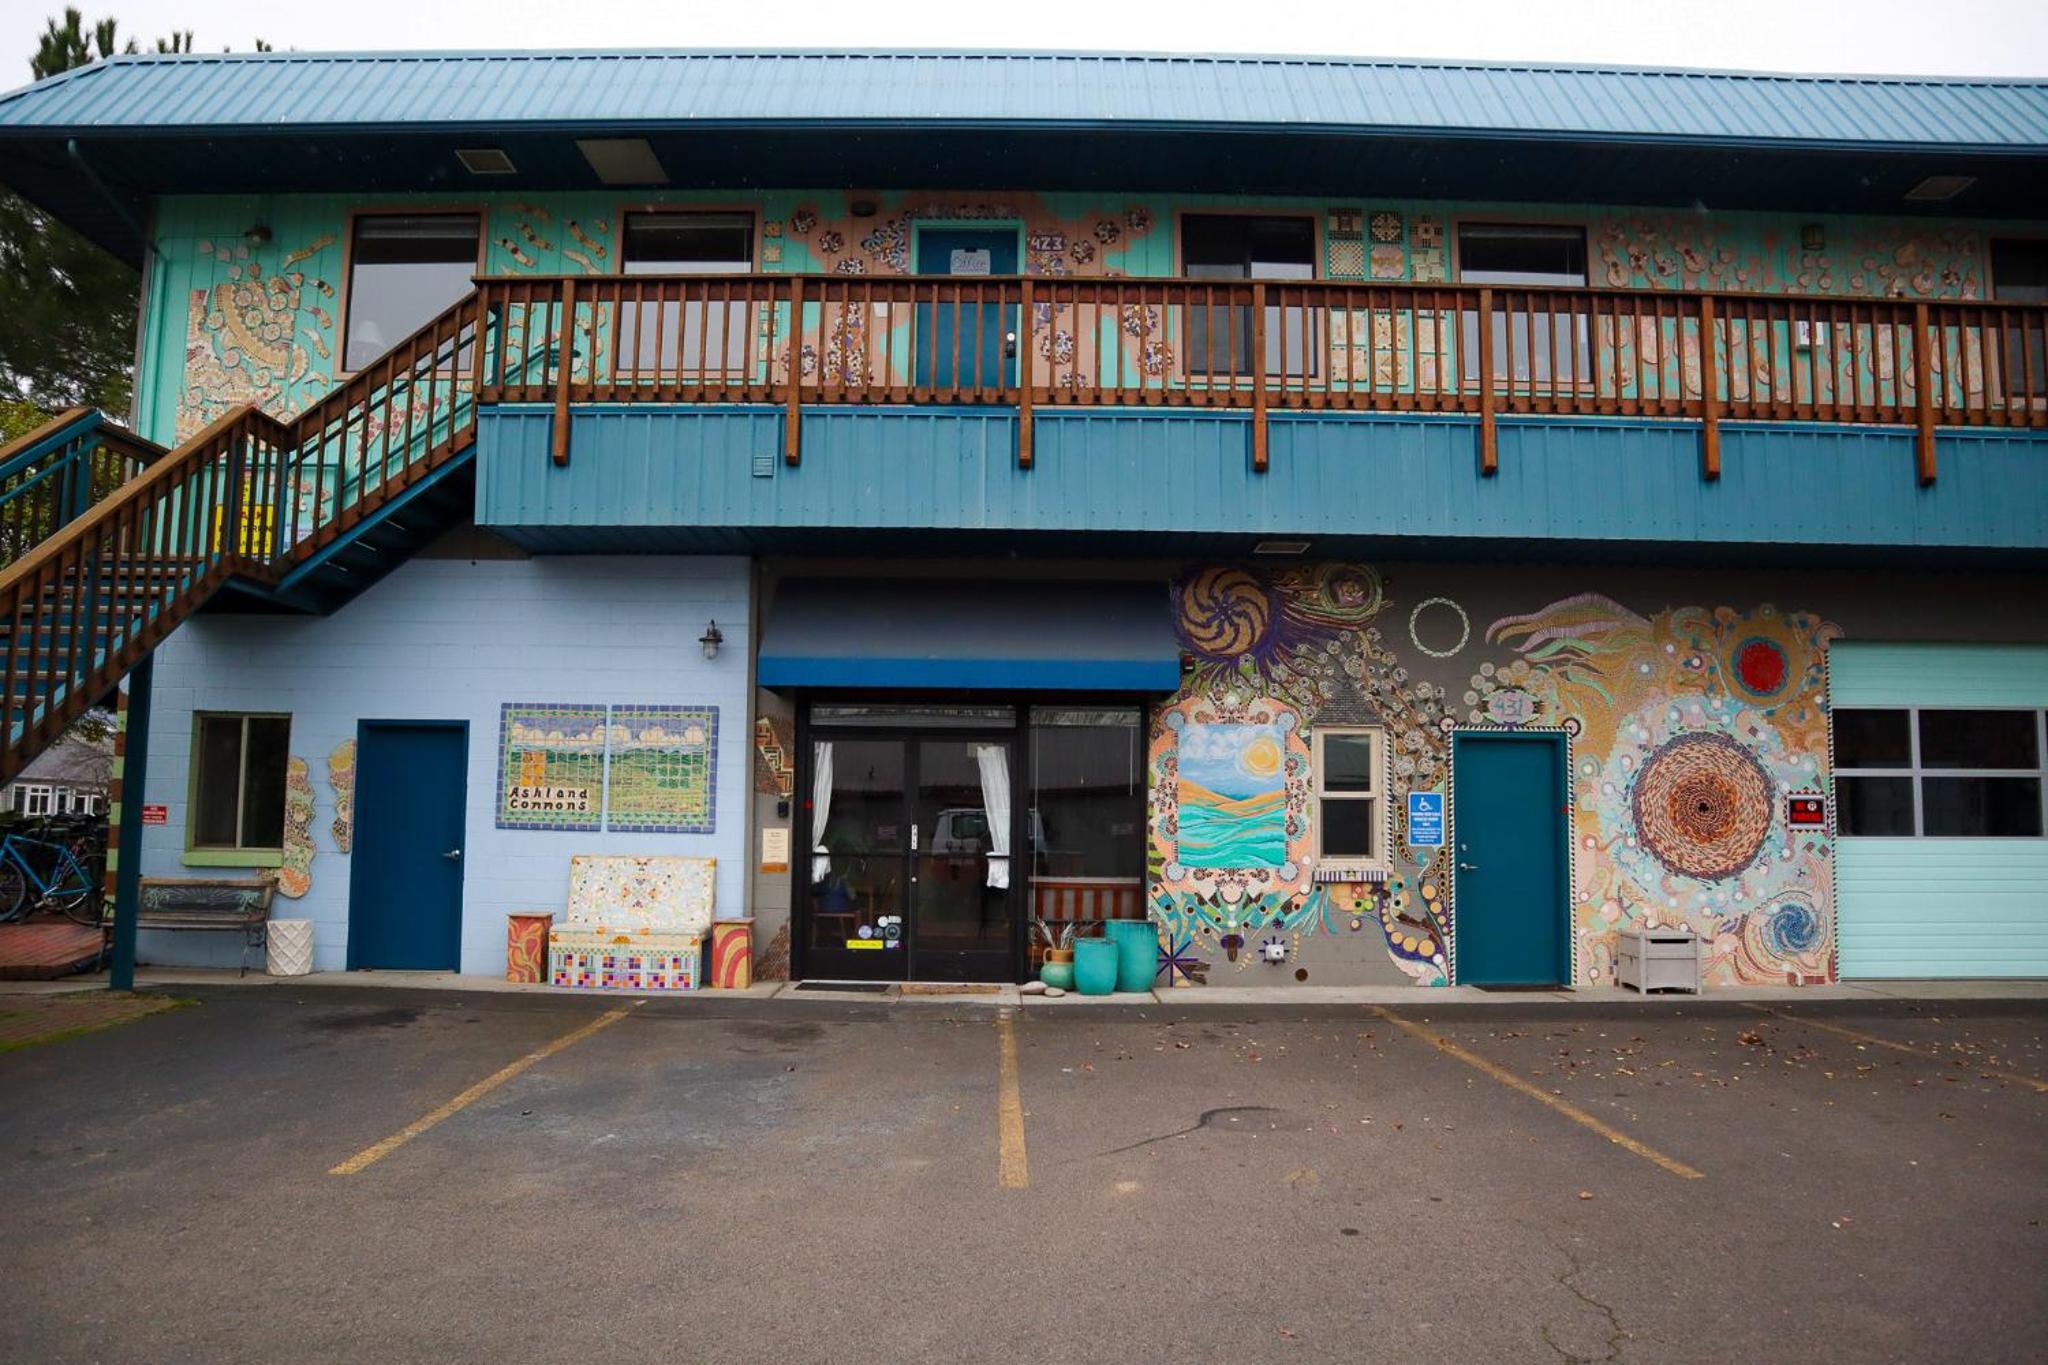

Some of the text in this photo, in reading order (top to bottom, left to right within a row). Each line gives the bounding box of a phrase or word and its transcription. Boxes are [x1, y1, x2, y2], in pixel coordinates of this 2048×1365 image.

[1031, 236, 1063, 251] 423
[509, 786, 588, 799] Ashland
[510, 799, 587, 810] Commons
